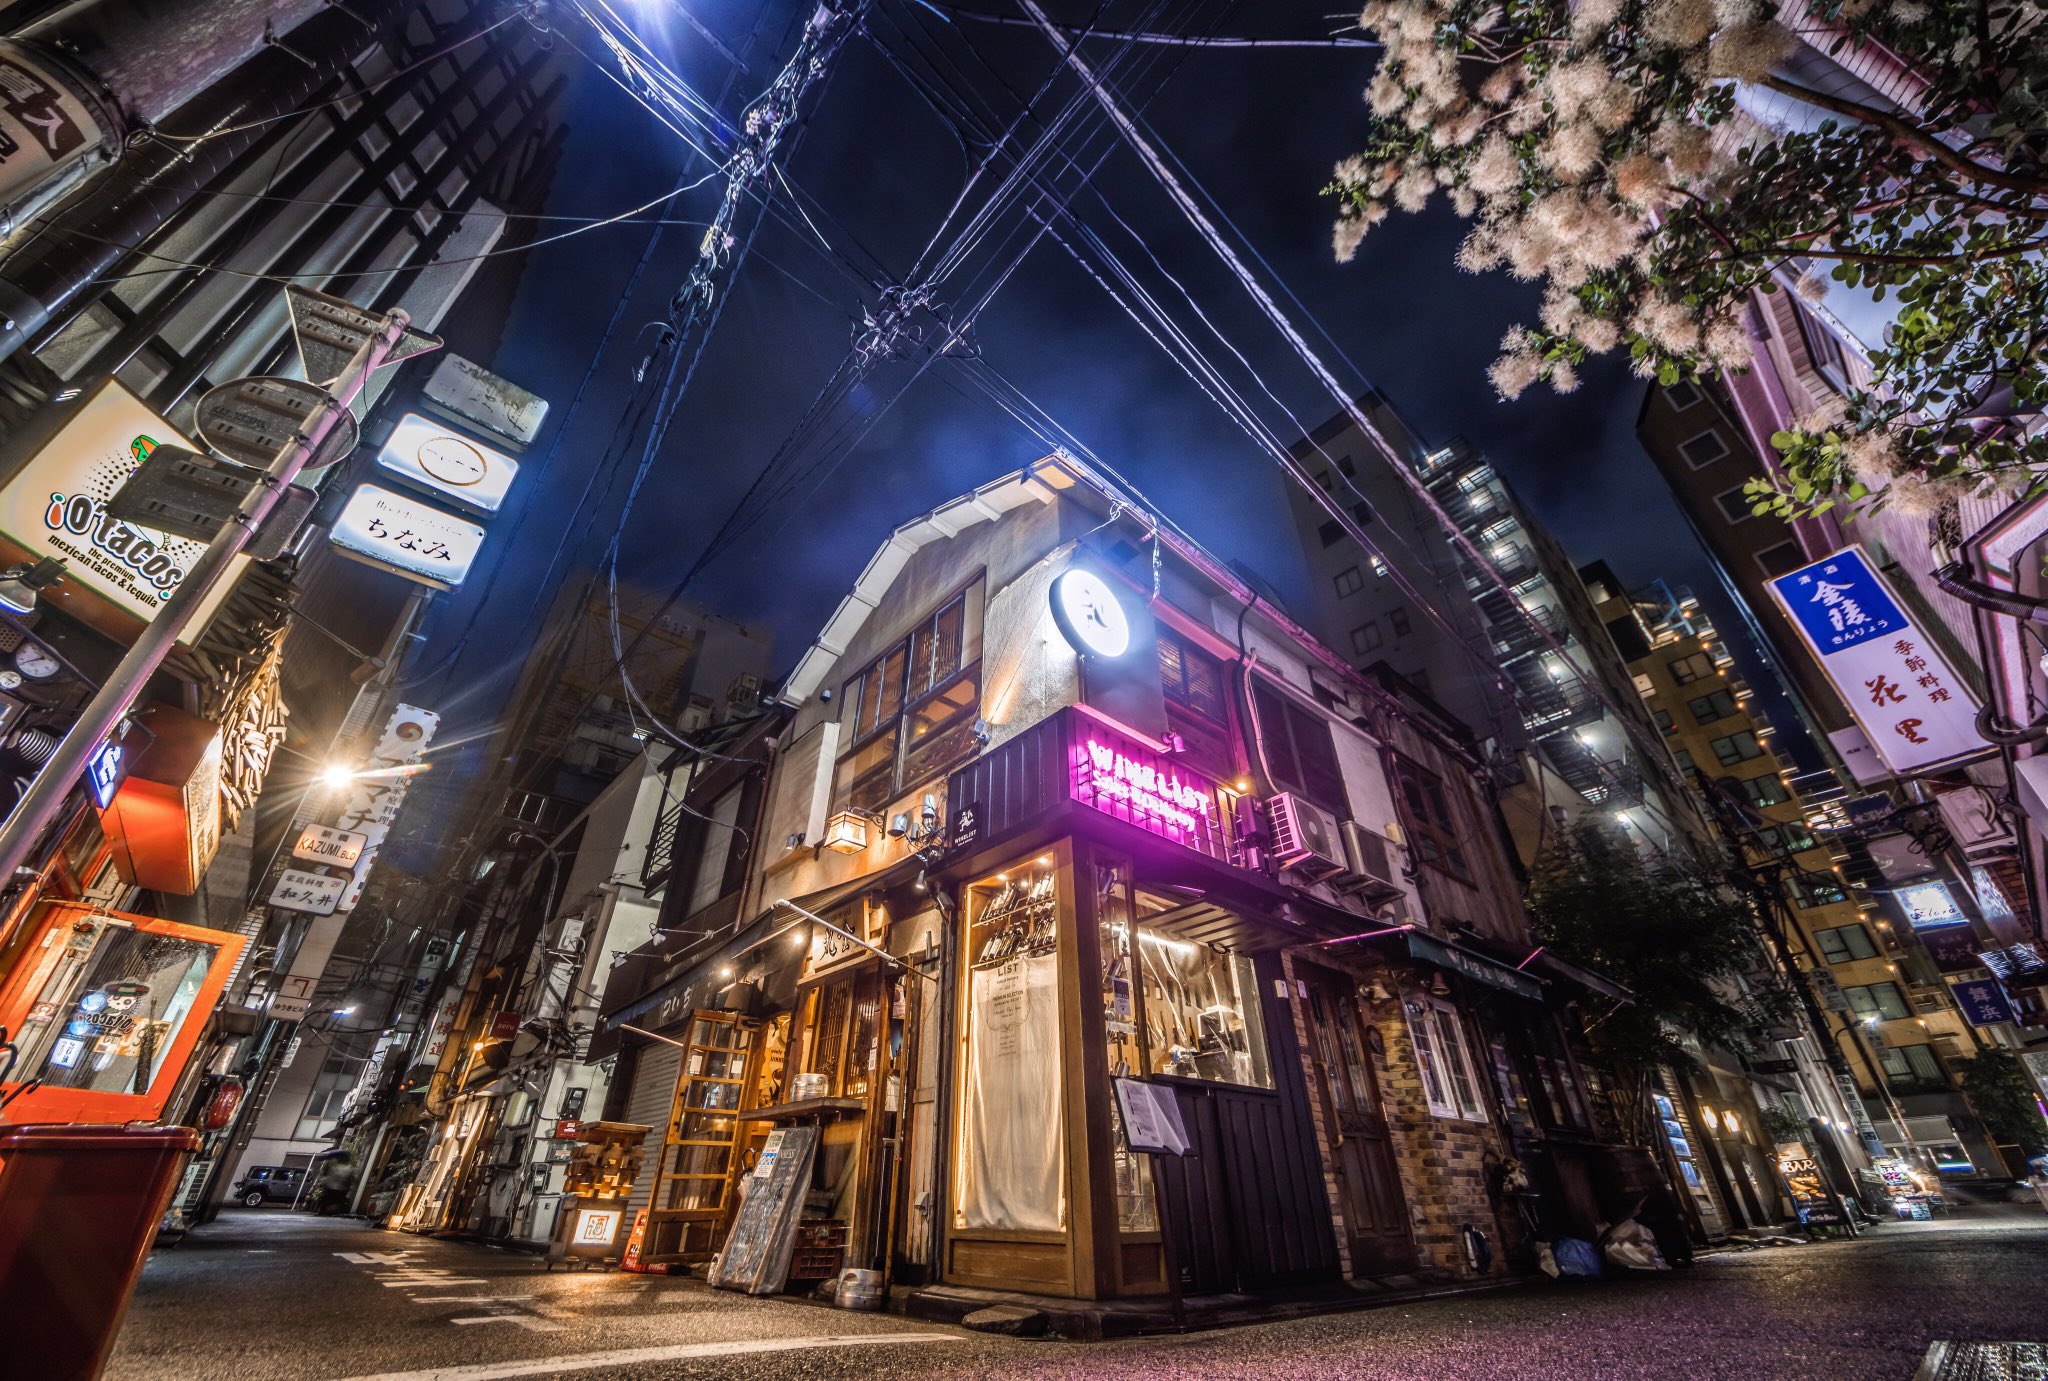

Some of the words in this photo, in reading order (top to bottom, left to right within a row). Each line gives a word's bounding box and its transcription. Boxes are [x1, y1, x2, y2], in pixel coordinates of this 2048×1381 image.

[368, 518, 450, 561] ちなみ
[48, 534, 91, 566] mexican
[90, 561, 118, 583] tacos
[118, 576, 126, 588] &
[126, 581, 158, 608] tequila
[88, 547, 101, 561] the
[102, 557, 135, 582] premium
[1797, 564, 1838, 585] 清酒
[1809, 580, 1872, 631] 金陵
[1831, 620, 1889, 645] きんりょう
[1893, 639, 1952, 703] 季節料理
[954, 829, 977, 844] WINELIST
[286, 874, 324, 888] 家庭料理
[330, 880, 341, 888] 2F
[280, 887, 332, 907] 和久井
[997, 963, 1019, 977] LIST
[274, 1003, 305, 1013] ゆうきビル
[1968, 986, 2002, 1020] 舞浜
[496, 1023, 516, 1031] aeru
[1782, 1159, 1817, 1173] BAR
